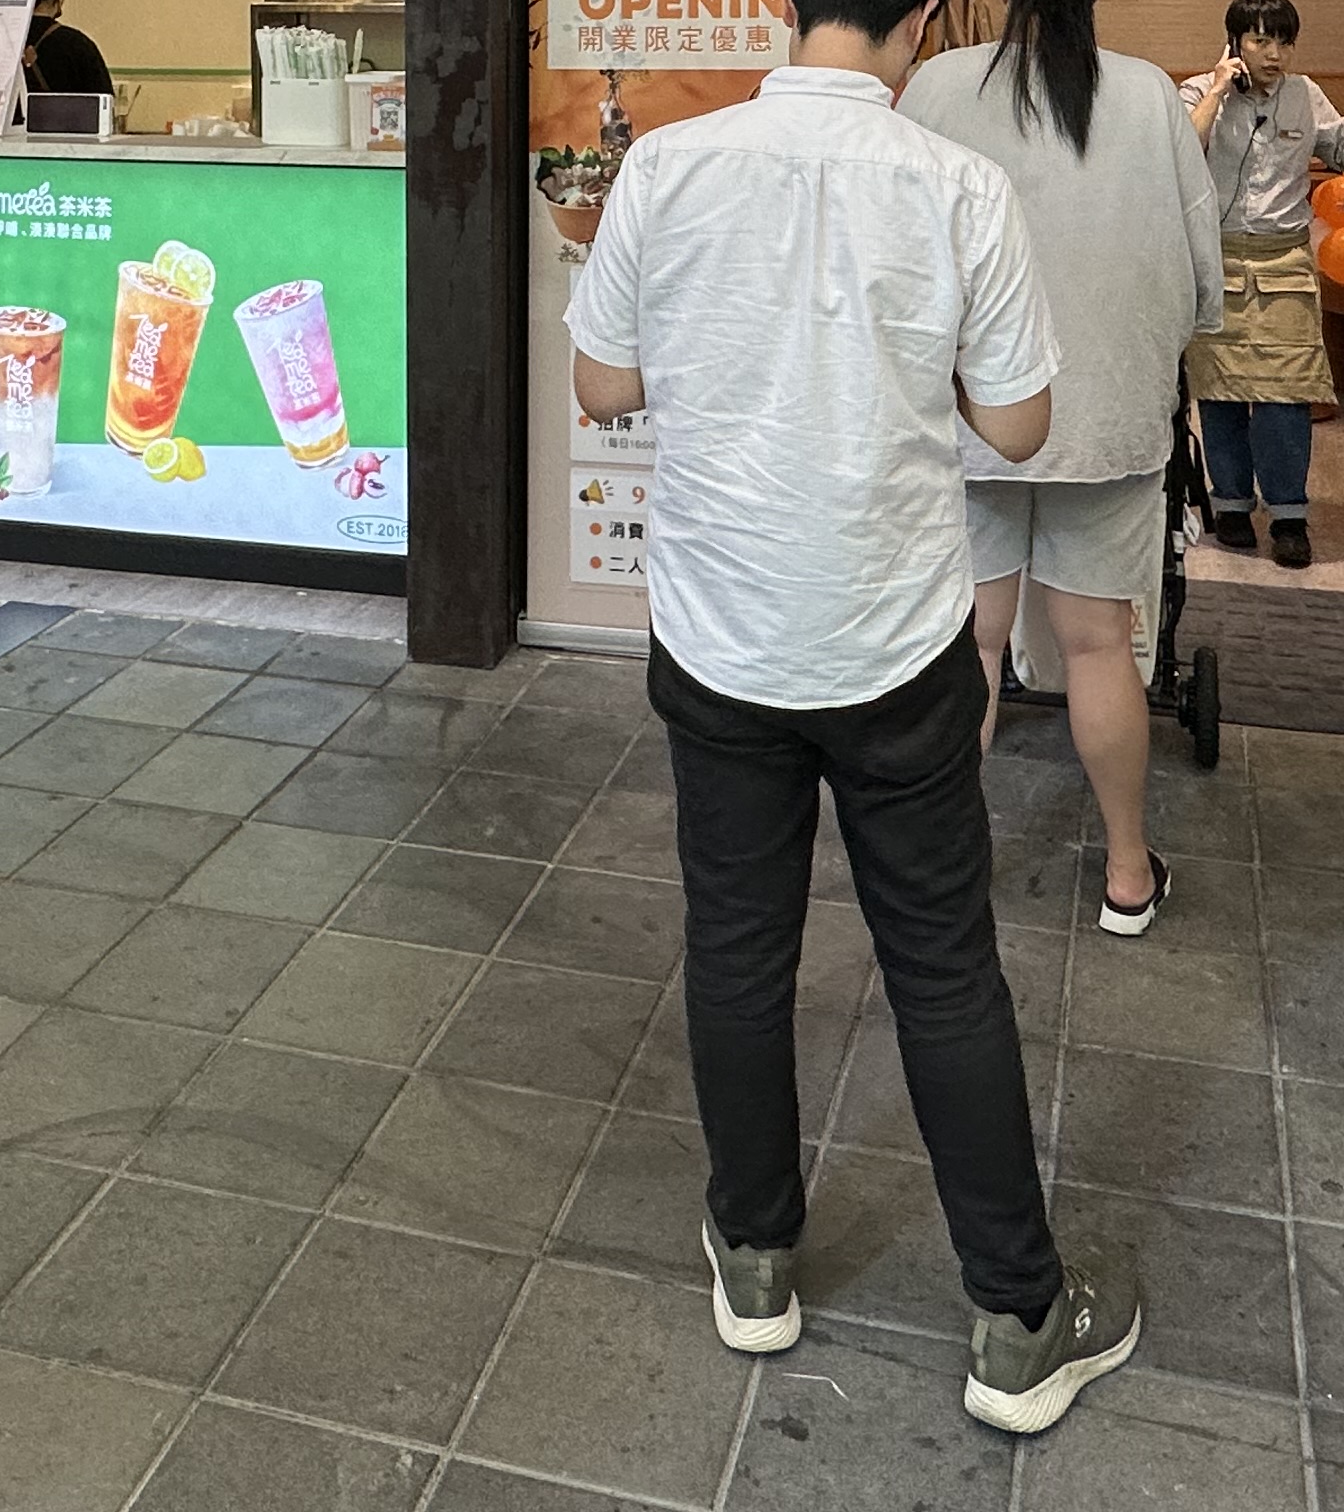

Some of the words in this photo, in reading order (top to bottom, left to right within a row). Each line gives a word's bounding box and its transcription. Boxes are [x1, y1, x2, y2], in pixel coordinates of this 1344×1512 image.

[577, 24, 773, 54] 開業限定優惠
[59, 195, 113, 218] 茶米茶
[631, 485, 646, 505] 9
[609, 521, 644, 540] 消費
[609, 556, 644, 575] 二人
